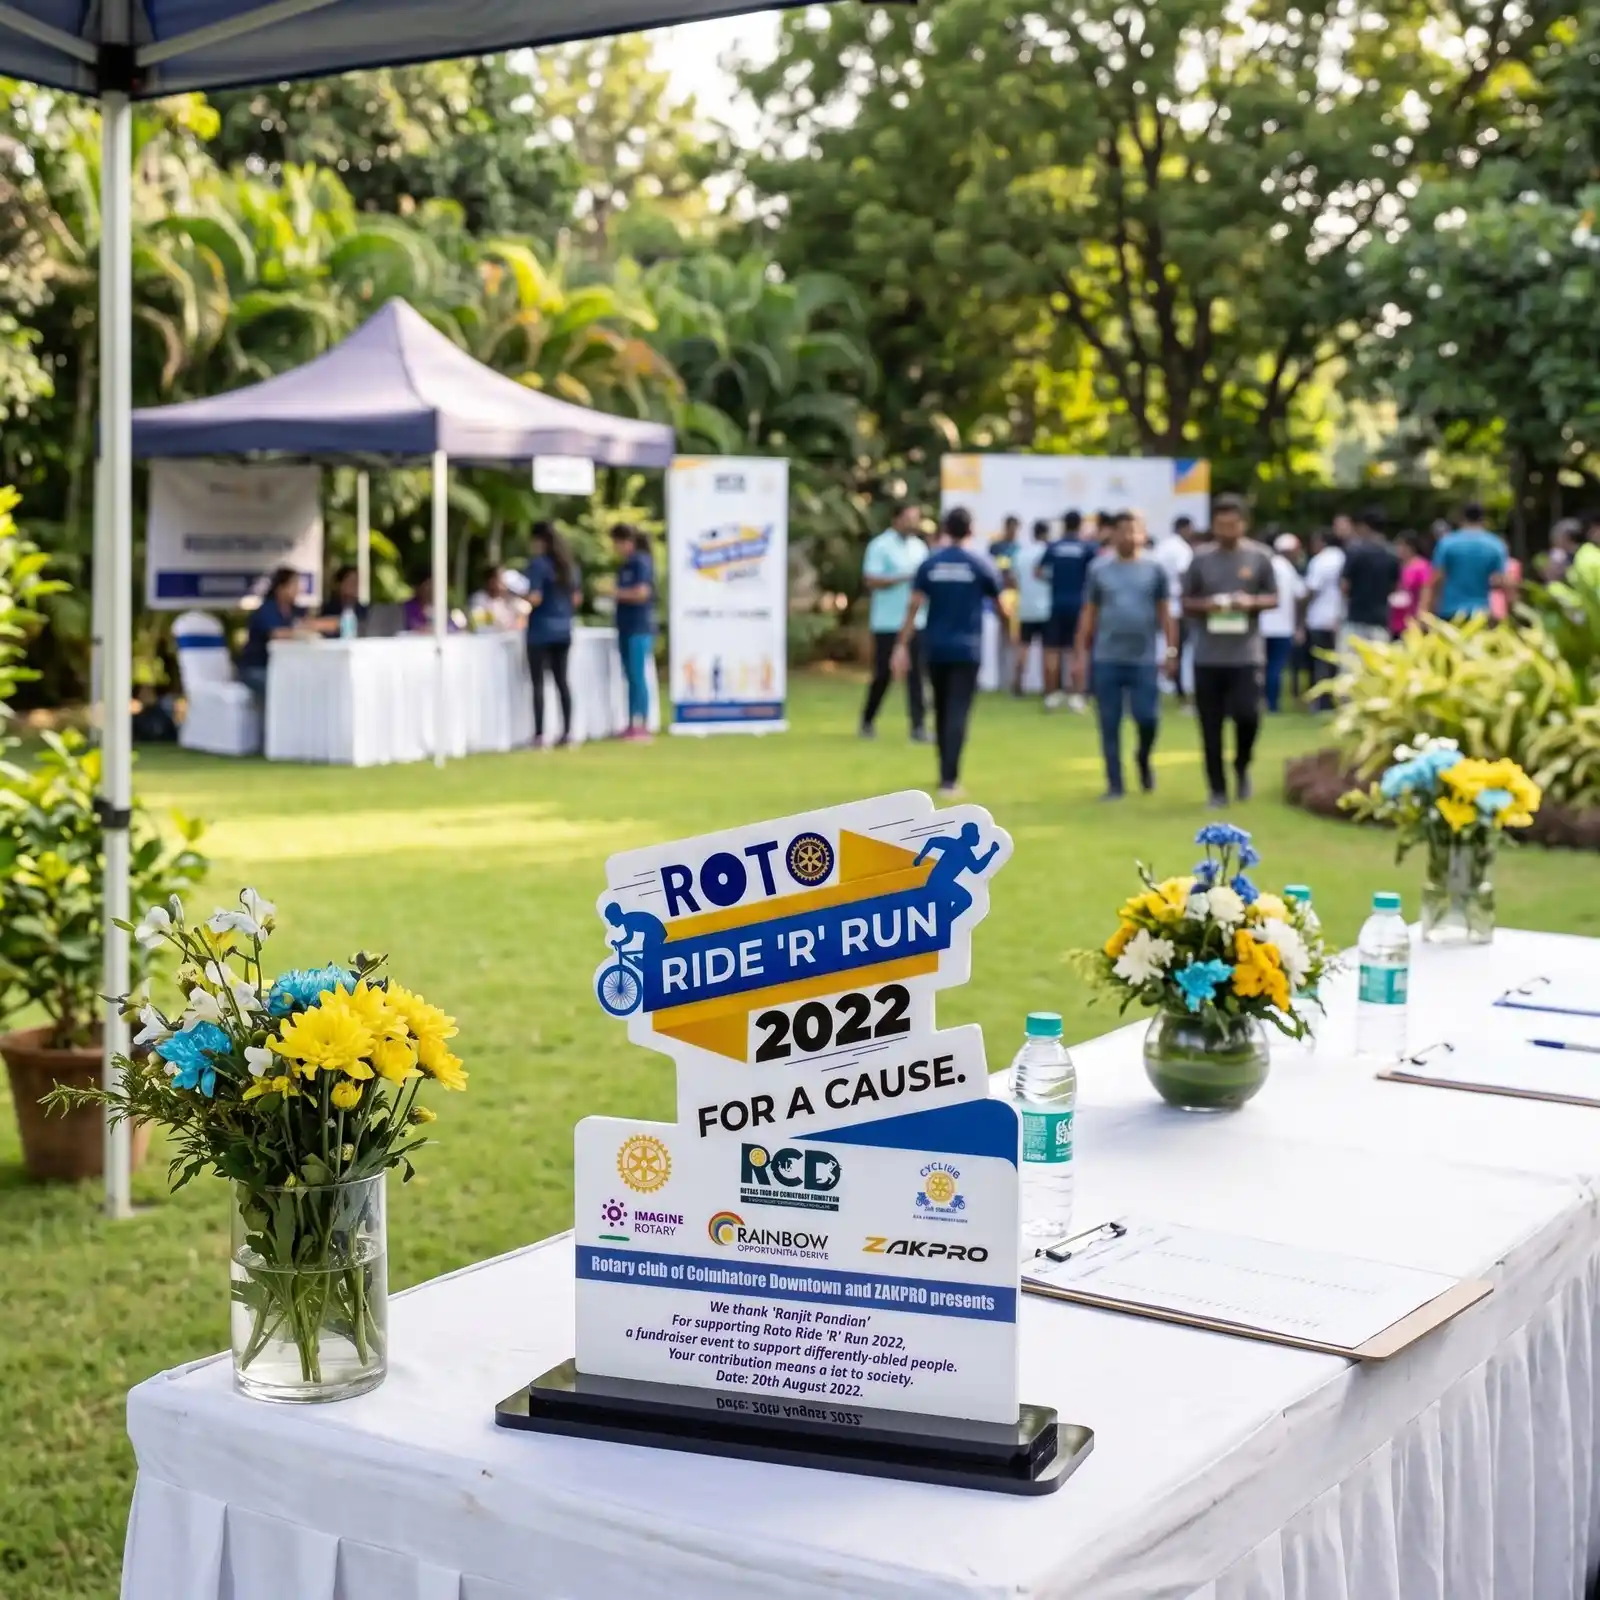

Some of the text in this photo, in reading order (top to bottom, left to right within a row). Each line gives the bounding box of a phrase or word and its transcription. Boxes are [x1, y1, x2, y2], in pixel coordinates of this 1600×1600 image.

[661, 902, 938, 994] RIDE 'R' RUN
[755, 984, 912, 1064] 2022
[698, 1054, 967, 1138] FOR A CAUSE.
[740, 1142, 842, 1192] RCD
[634, 1210, 684, 1225] IMAGINE
[634, 1223, 677, 1236] ROTARY
[737, 1227, 829, 1250] RAINBOW
[799, 1250, 829, 1260] DERIVE
[862, 1236, 989, 1263] ZAKPRO
[591, 1255, 635, 1276] Rotary
[638, 1260, 668, 1278] club
[671, 1264, 684, 1280] of
[769, 1273, 842, 1296] Downtown
[845, 1282, 872, 1299] and
[874, 1283, 927, 1304] ZAKPRO
[930, 1290, 995, 1311] presents
[710, 1300, 730, 1314] We
[733, 1303, 768, 1318] thank
[772, 1306, 812, 1324] 'Ranjit
[625, 1326, 958, 1373] a fundraiser event to support differently-abled people.
[672, 1314, 692, 1327] For
[694, 1318, 760, 1337] supporting
[763, 1323, 792, 1338] Roto
[795, 1326, 823, 1341] Ride
[844, 1332, 869, 1346] Run
[871, 1334, 906, 1351] 2022,
[669, 1347, 696, 1361] Your
[698, 1353, 772, 1370] contribution
[775, 1360, 816, 1375] means
[819, 1365, 827, 1376] a
[851, 1367, 864, 1380] to
[867, 1370, 914, 1388] society.
[716, 1369, 864, 1397] Date: 20th August 2022.
